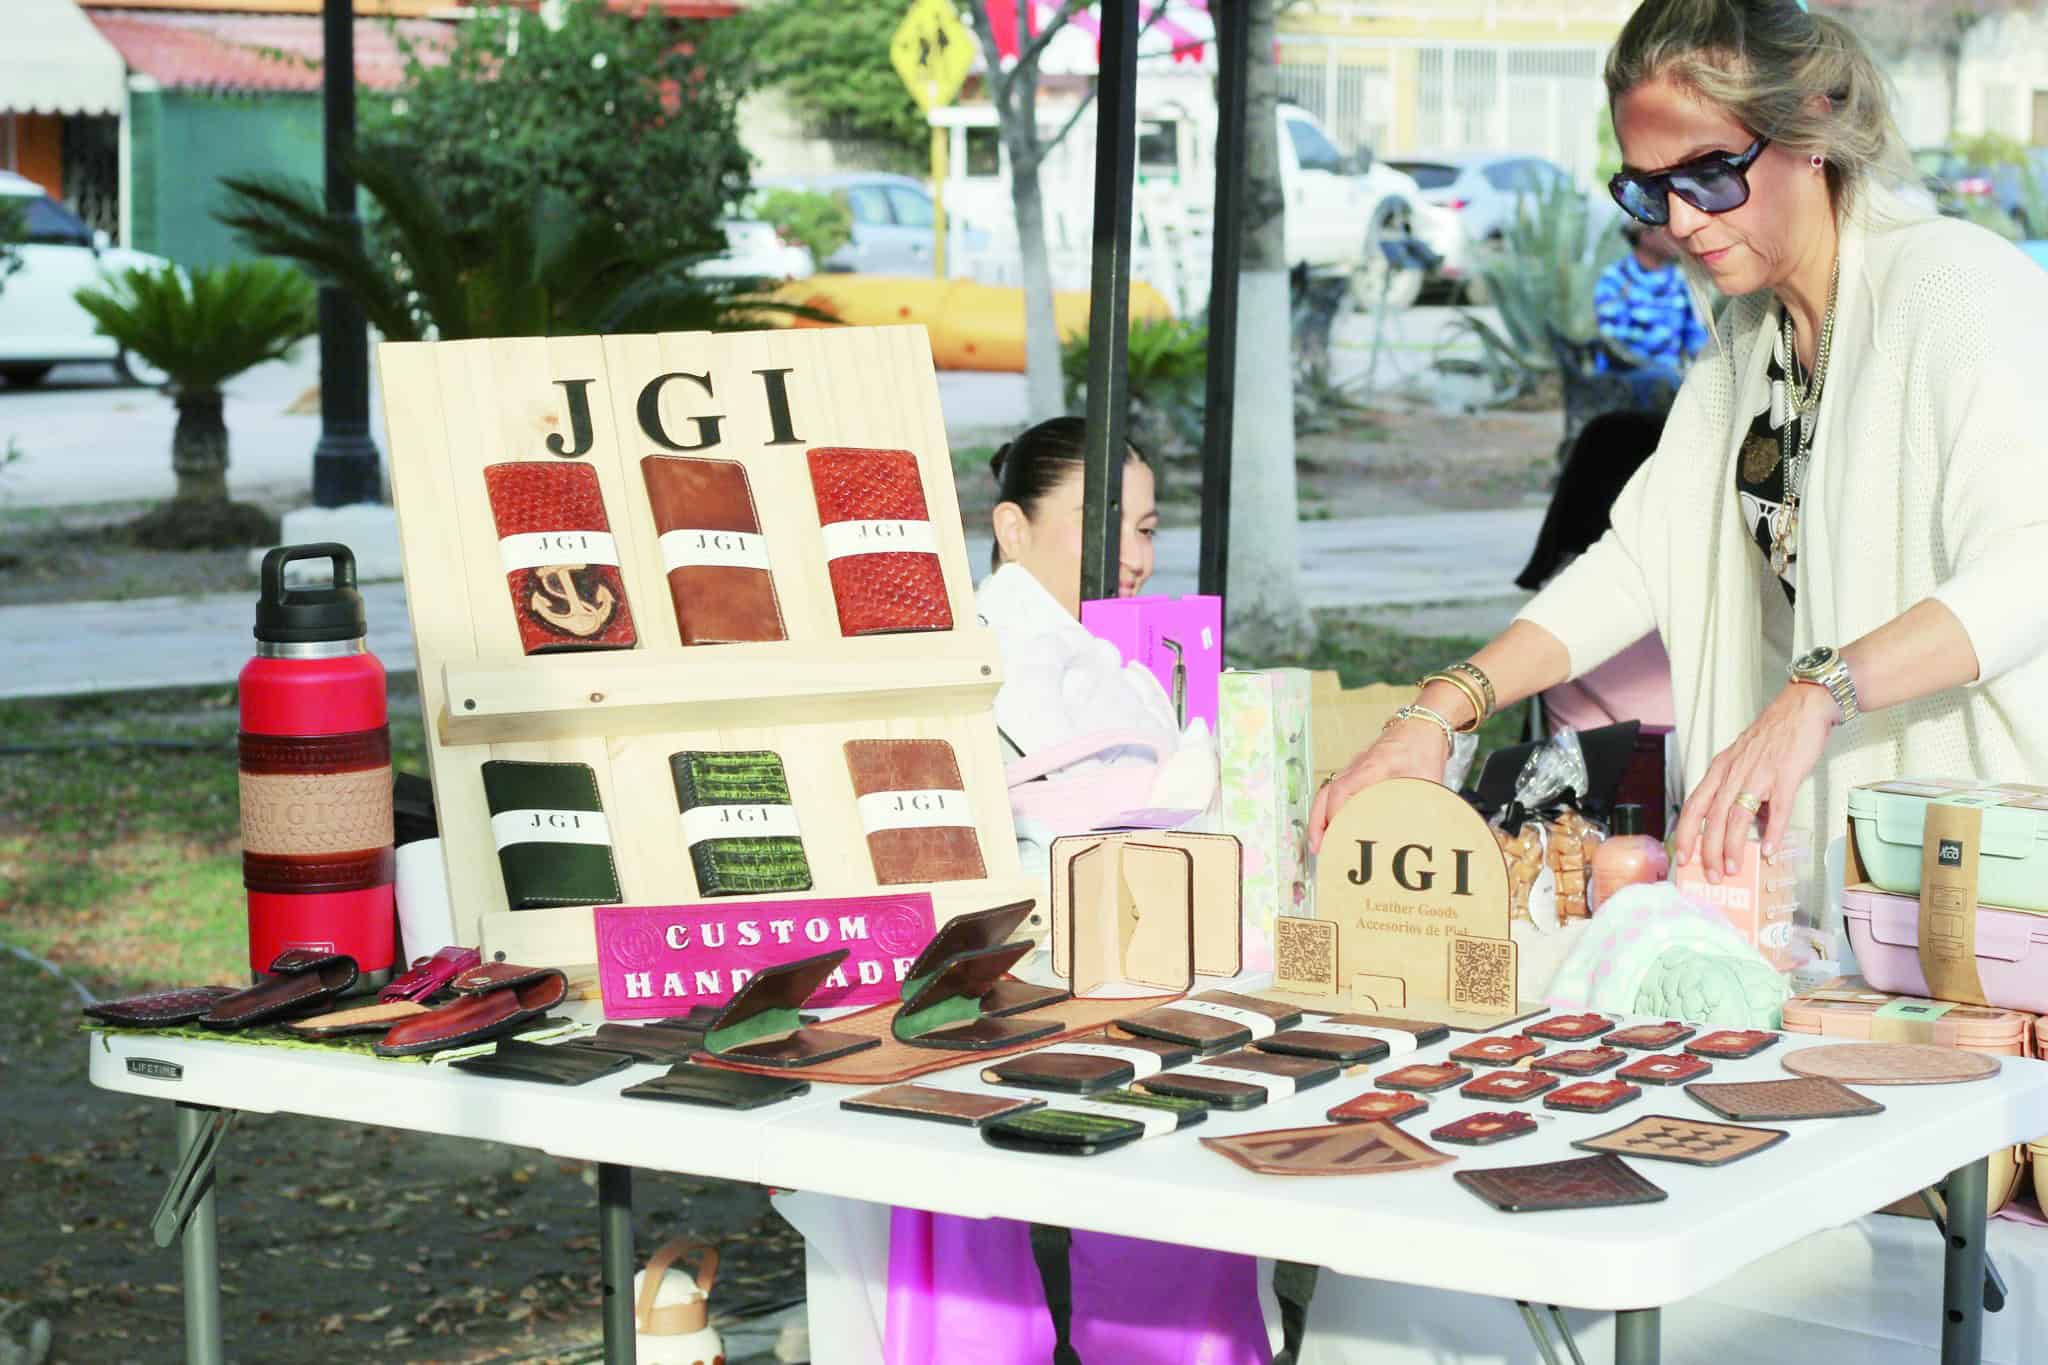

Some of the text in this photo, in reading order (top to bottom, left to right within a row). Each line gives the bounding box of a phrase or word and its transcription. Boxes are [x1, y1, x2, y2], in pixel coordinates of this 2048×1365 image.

[1347, 839, 1475, 896] JGI
[1363, 898, 1458, 919] Leather Goods
[665, 916, 869, 950] CUSTOM
[1425, 924, 1440, 937] de
[132, 1061, 177, 1076] LIFETIME
